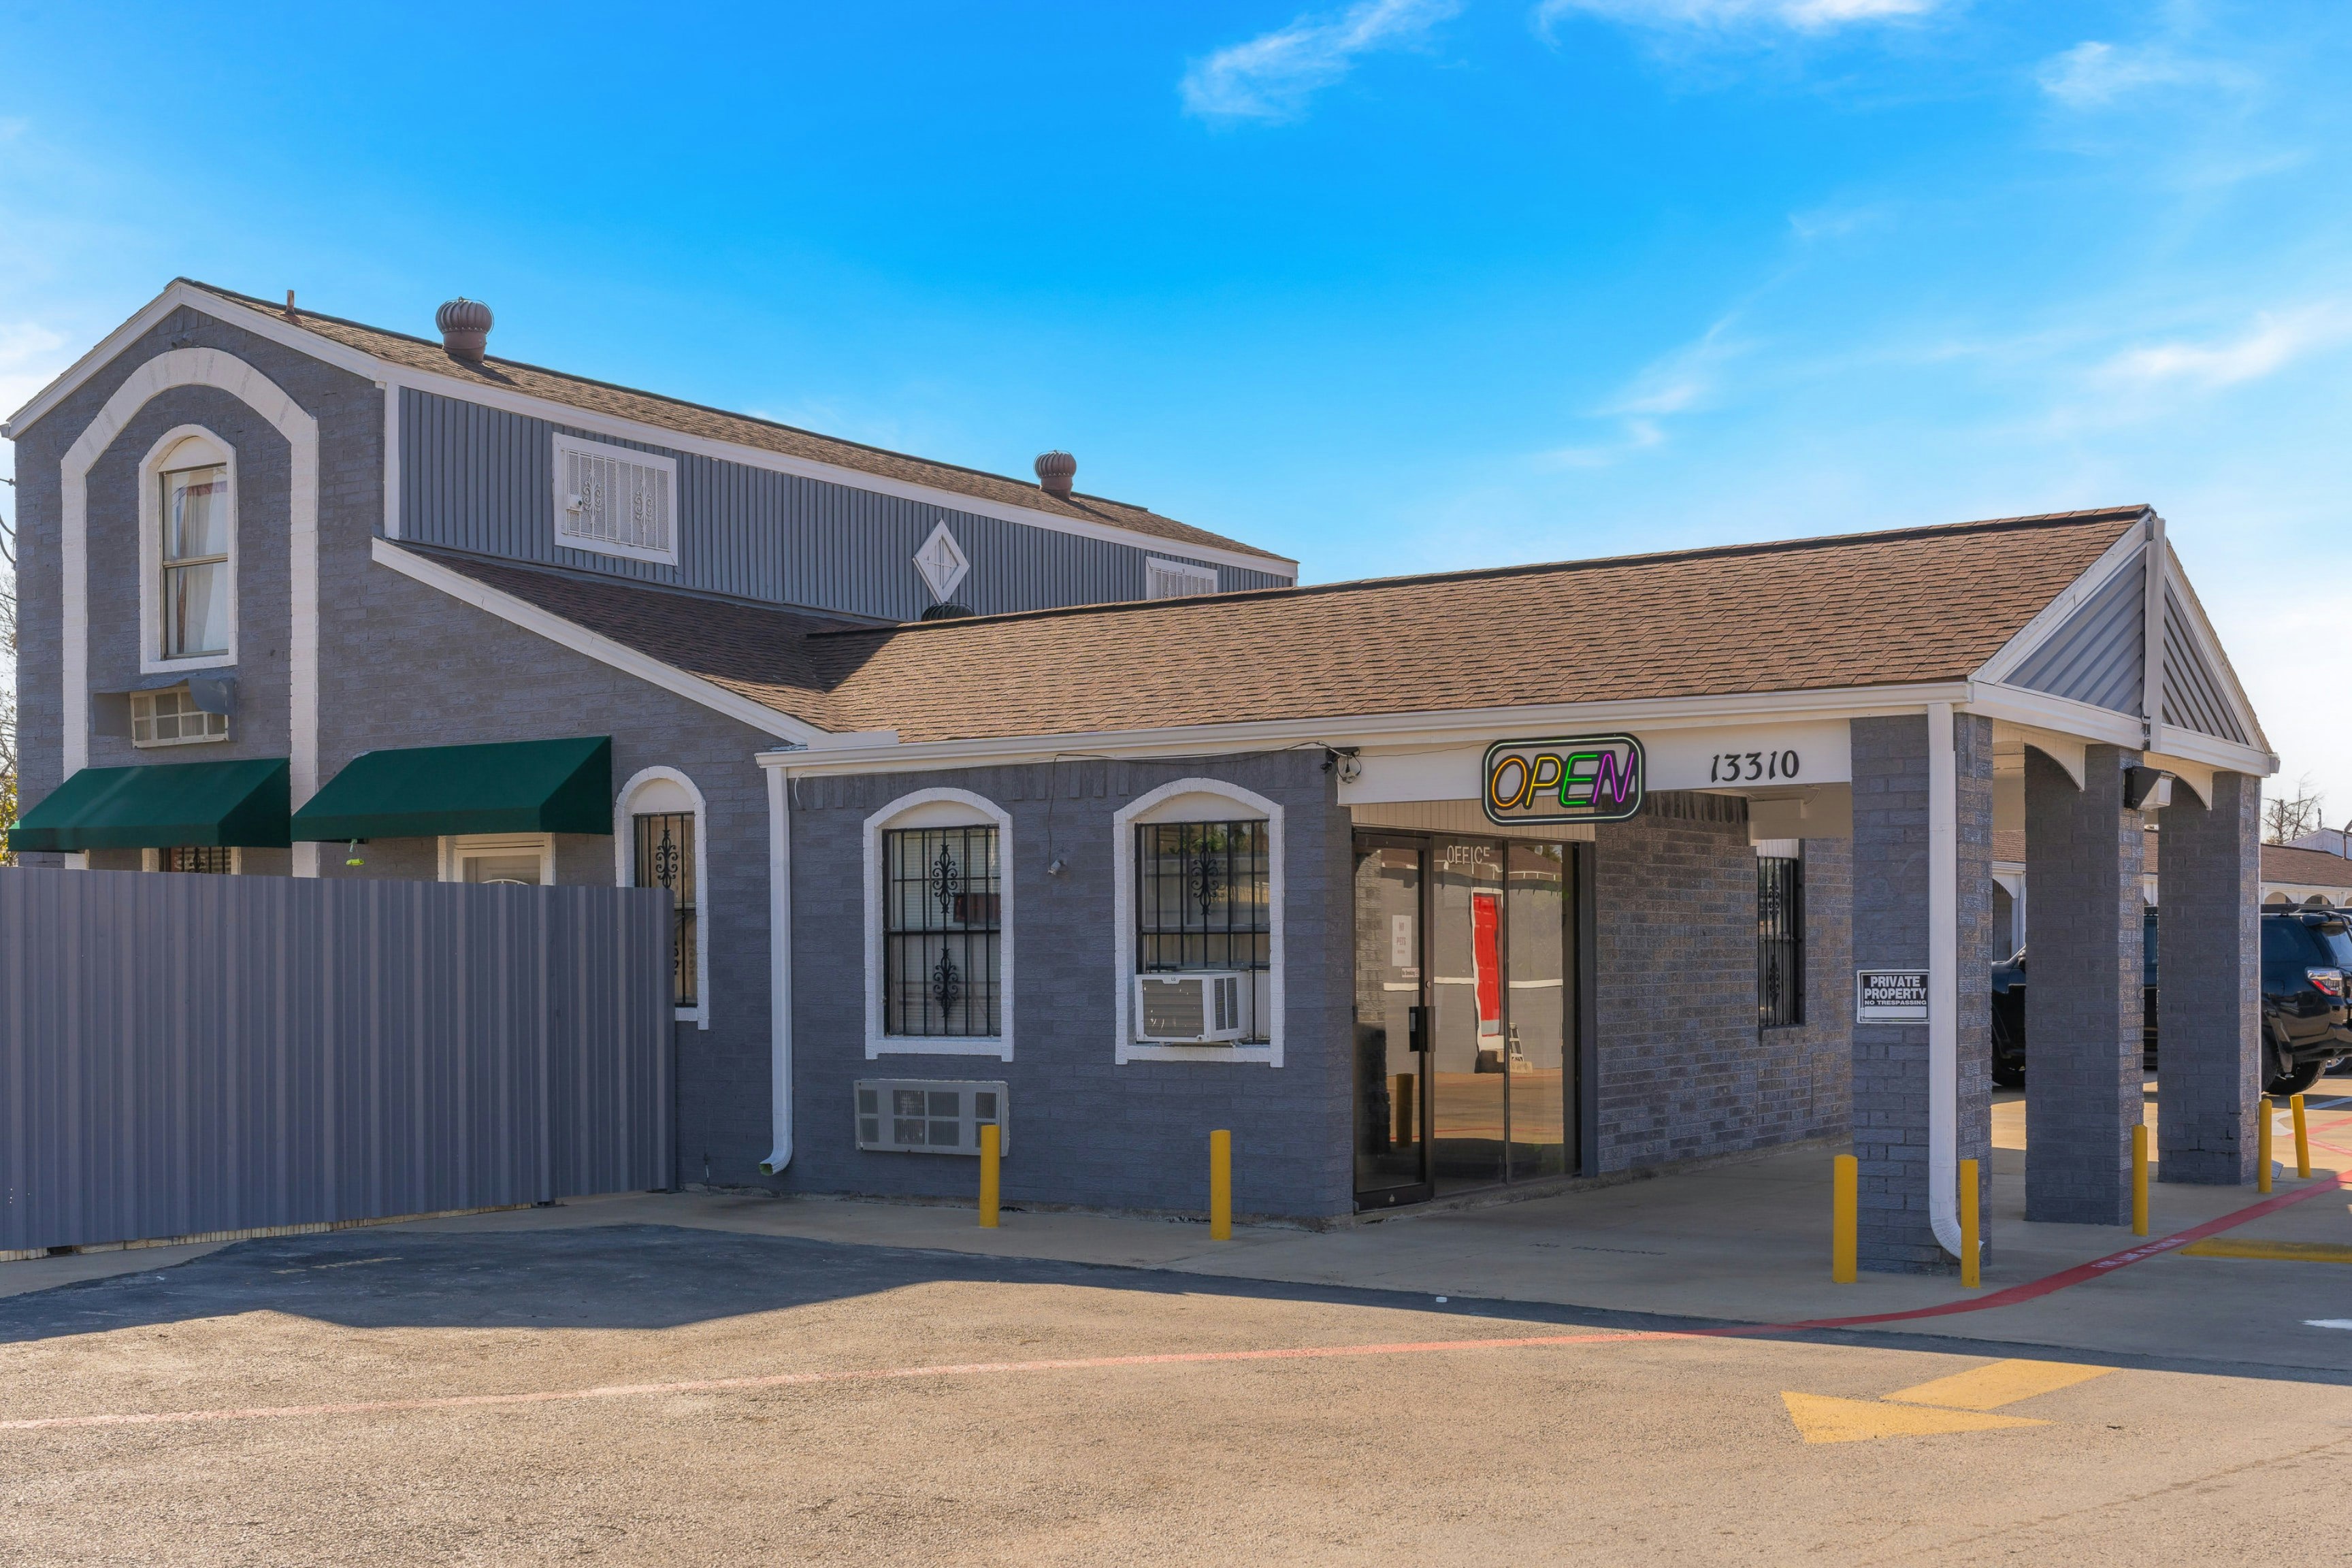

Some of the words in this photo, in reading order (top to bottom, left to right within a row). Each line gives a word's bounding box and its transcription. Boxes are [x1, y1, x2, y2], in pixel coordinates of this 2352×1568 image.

[1711, 750, 1799, 783] 13310
[1491, 751, 1635, 808] OPEN
[1870, 975, 1921, 987] PRIVATE
[1864, 987, 1927, 1000] PROPERTY
